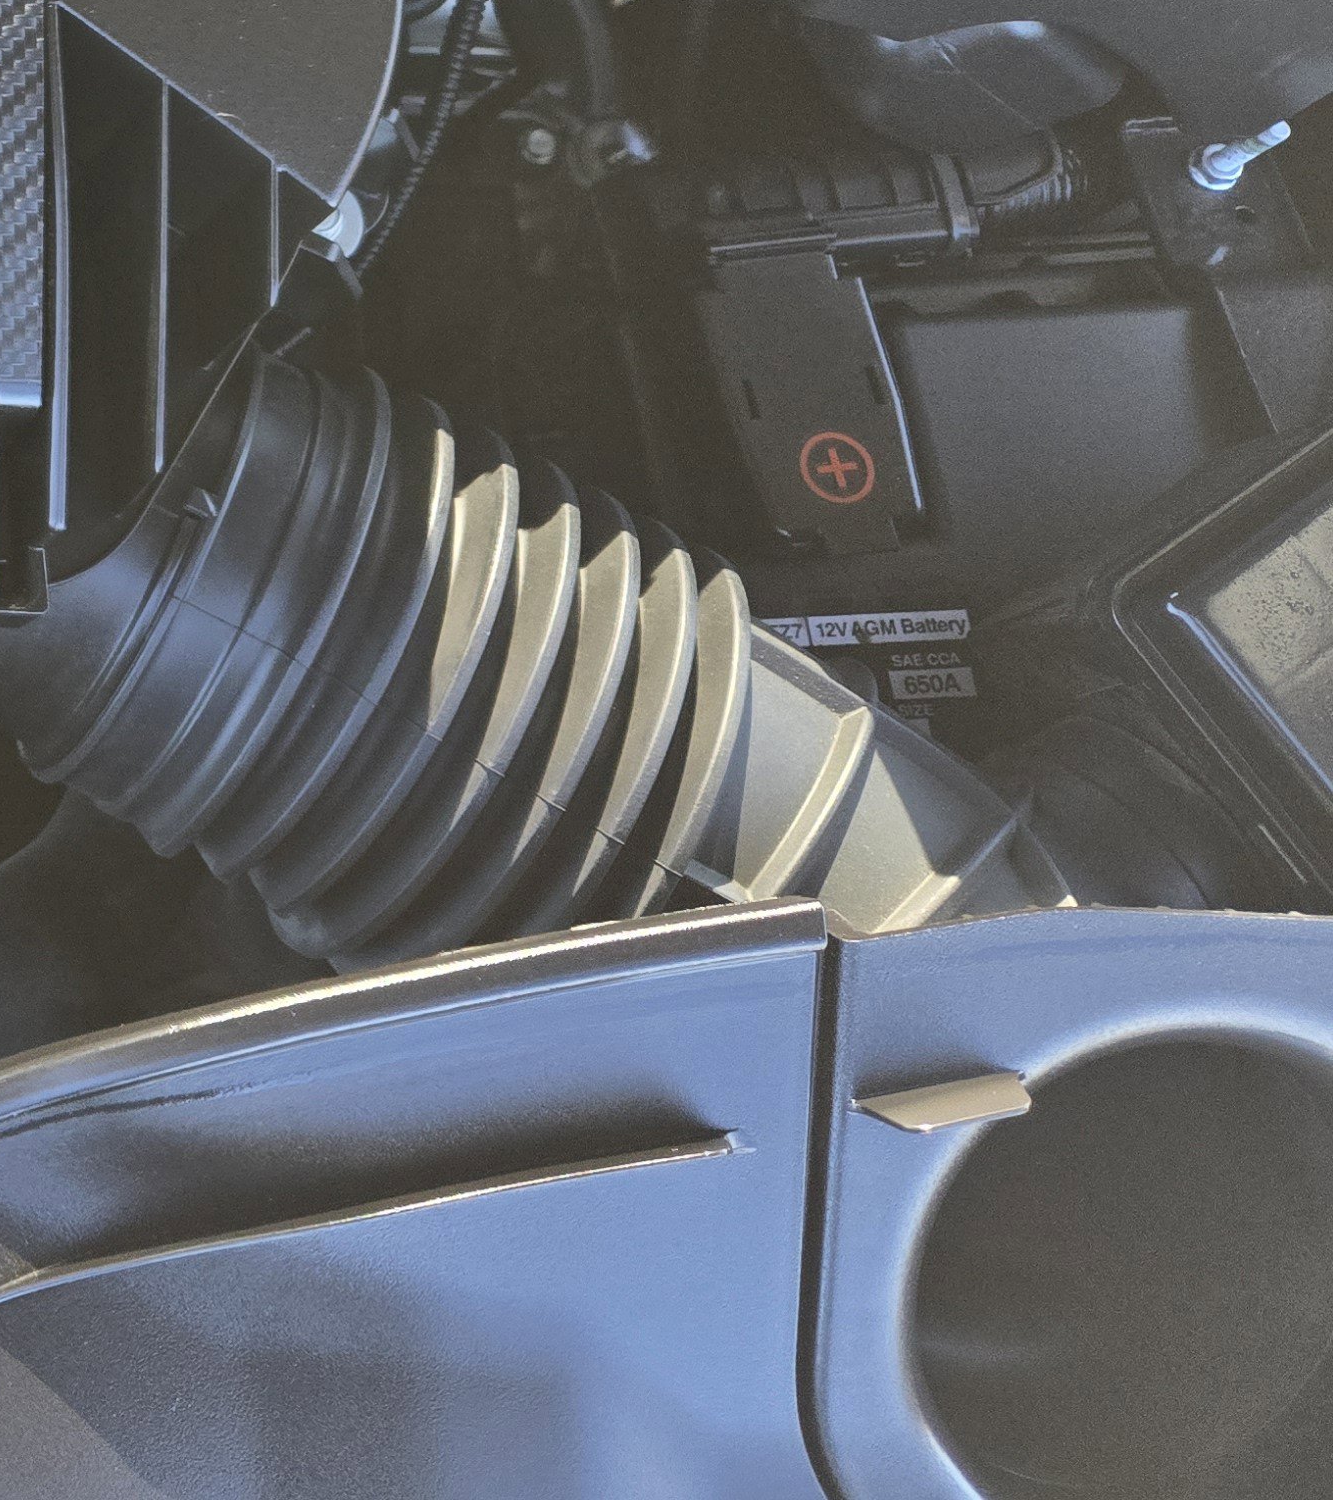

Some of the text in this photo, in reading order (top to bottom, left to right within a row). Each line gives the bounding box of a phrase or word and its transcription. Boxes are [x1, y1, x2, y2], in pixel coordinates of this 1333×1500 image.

[817, 617, 967, 639] 12V AGM Battery
[891, 651, 961, 668] SAE CCA
[903, 672, 962, 695] 650A
[897, 702, 935, 718] SIZE
